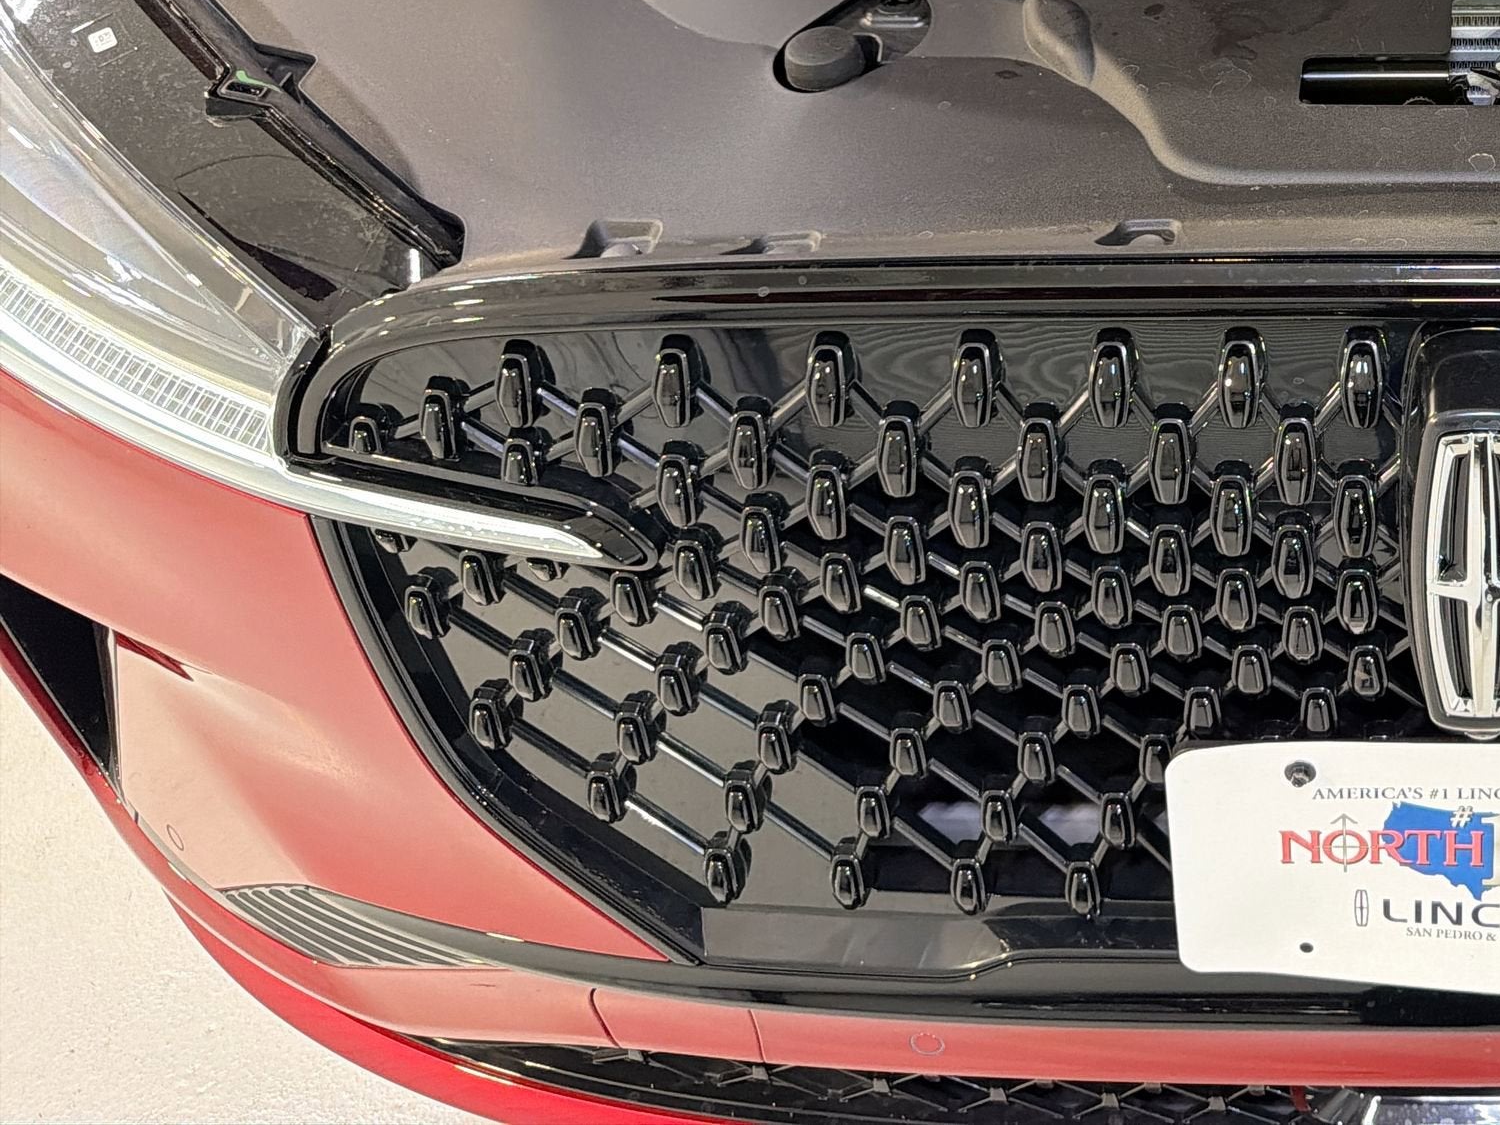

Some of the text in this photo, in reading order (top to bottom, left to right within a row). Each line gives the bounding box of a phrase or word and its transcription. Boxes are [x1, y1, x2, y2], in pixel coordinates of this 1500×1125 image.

[1312, 787, 1423, 800] AMERICA'S
[1429, 787, 1448, 800] #1
[1279, 829, 1485, 868] NORTH
[1405, 926, 1433, 938] SAN
[1436, 929, 1483, 941] PEDRO
[1485, 931, 1497, 942] &
